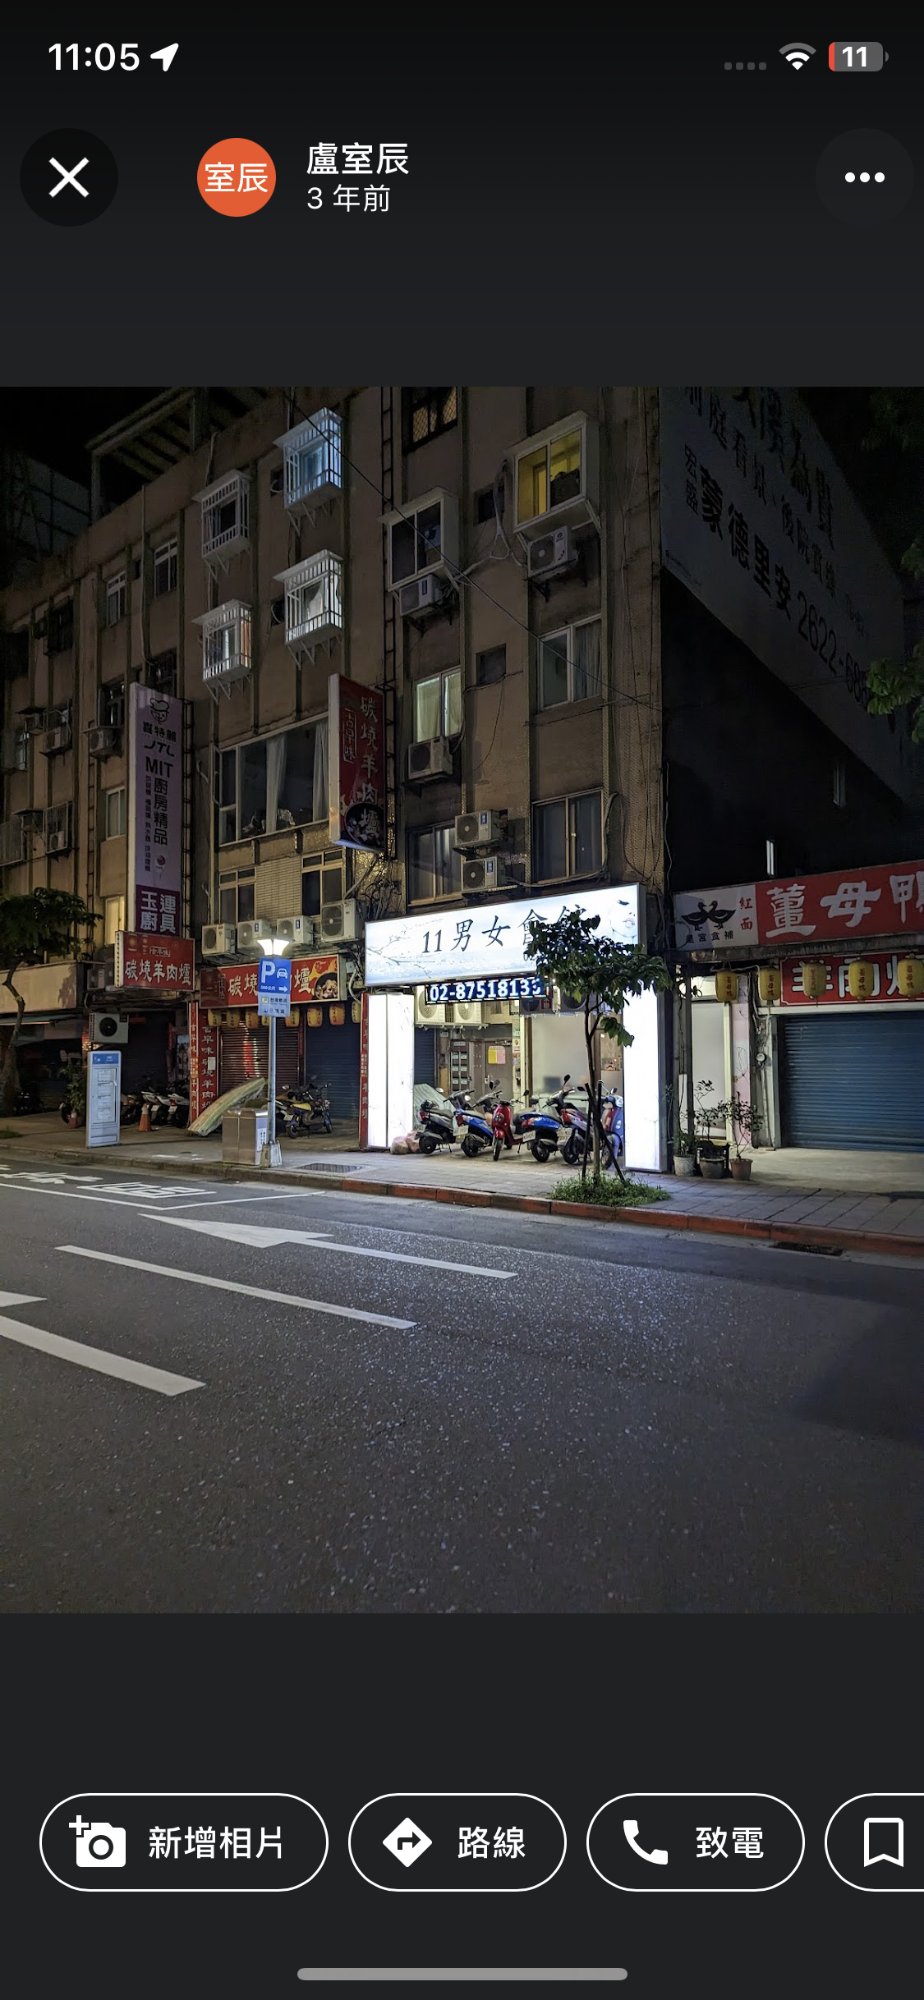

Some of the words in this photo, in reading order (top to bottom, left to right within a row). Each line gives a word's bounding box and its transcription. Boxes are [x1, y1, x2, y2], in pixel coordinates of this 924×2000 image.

[700, 464, 792, 621] 蒙德里安
[143, 740, 175, 757] JTL
[145, 755, 174, 778] MIT
[153, 777, 169, 846] 廚房精品
[739, 896, 753, 931] 紅面
[227, 967, 312, 998] 碳燒爐
[261, 960, 276, 984] P
